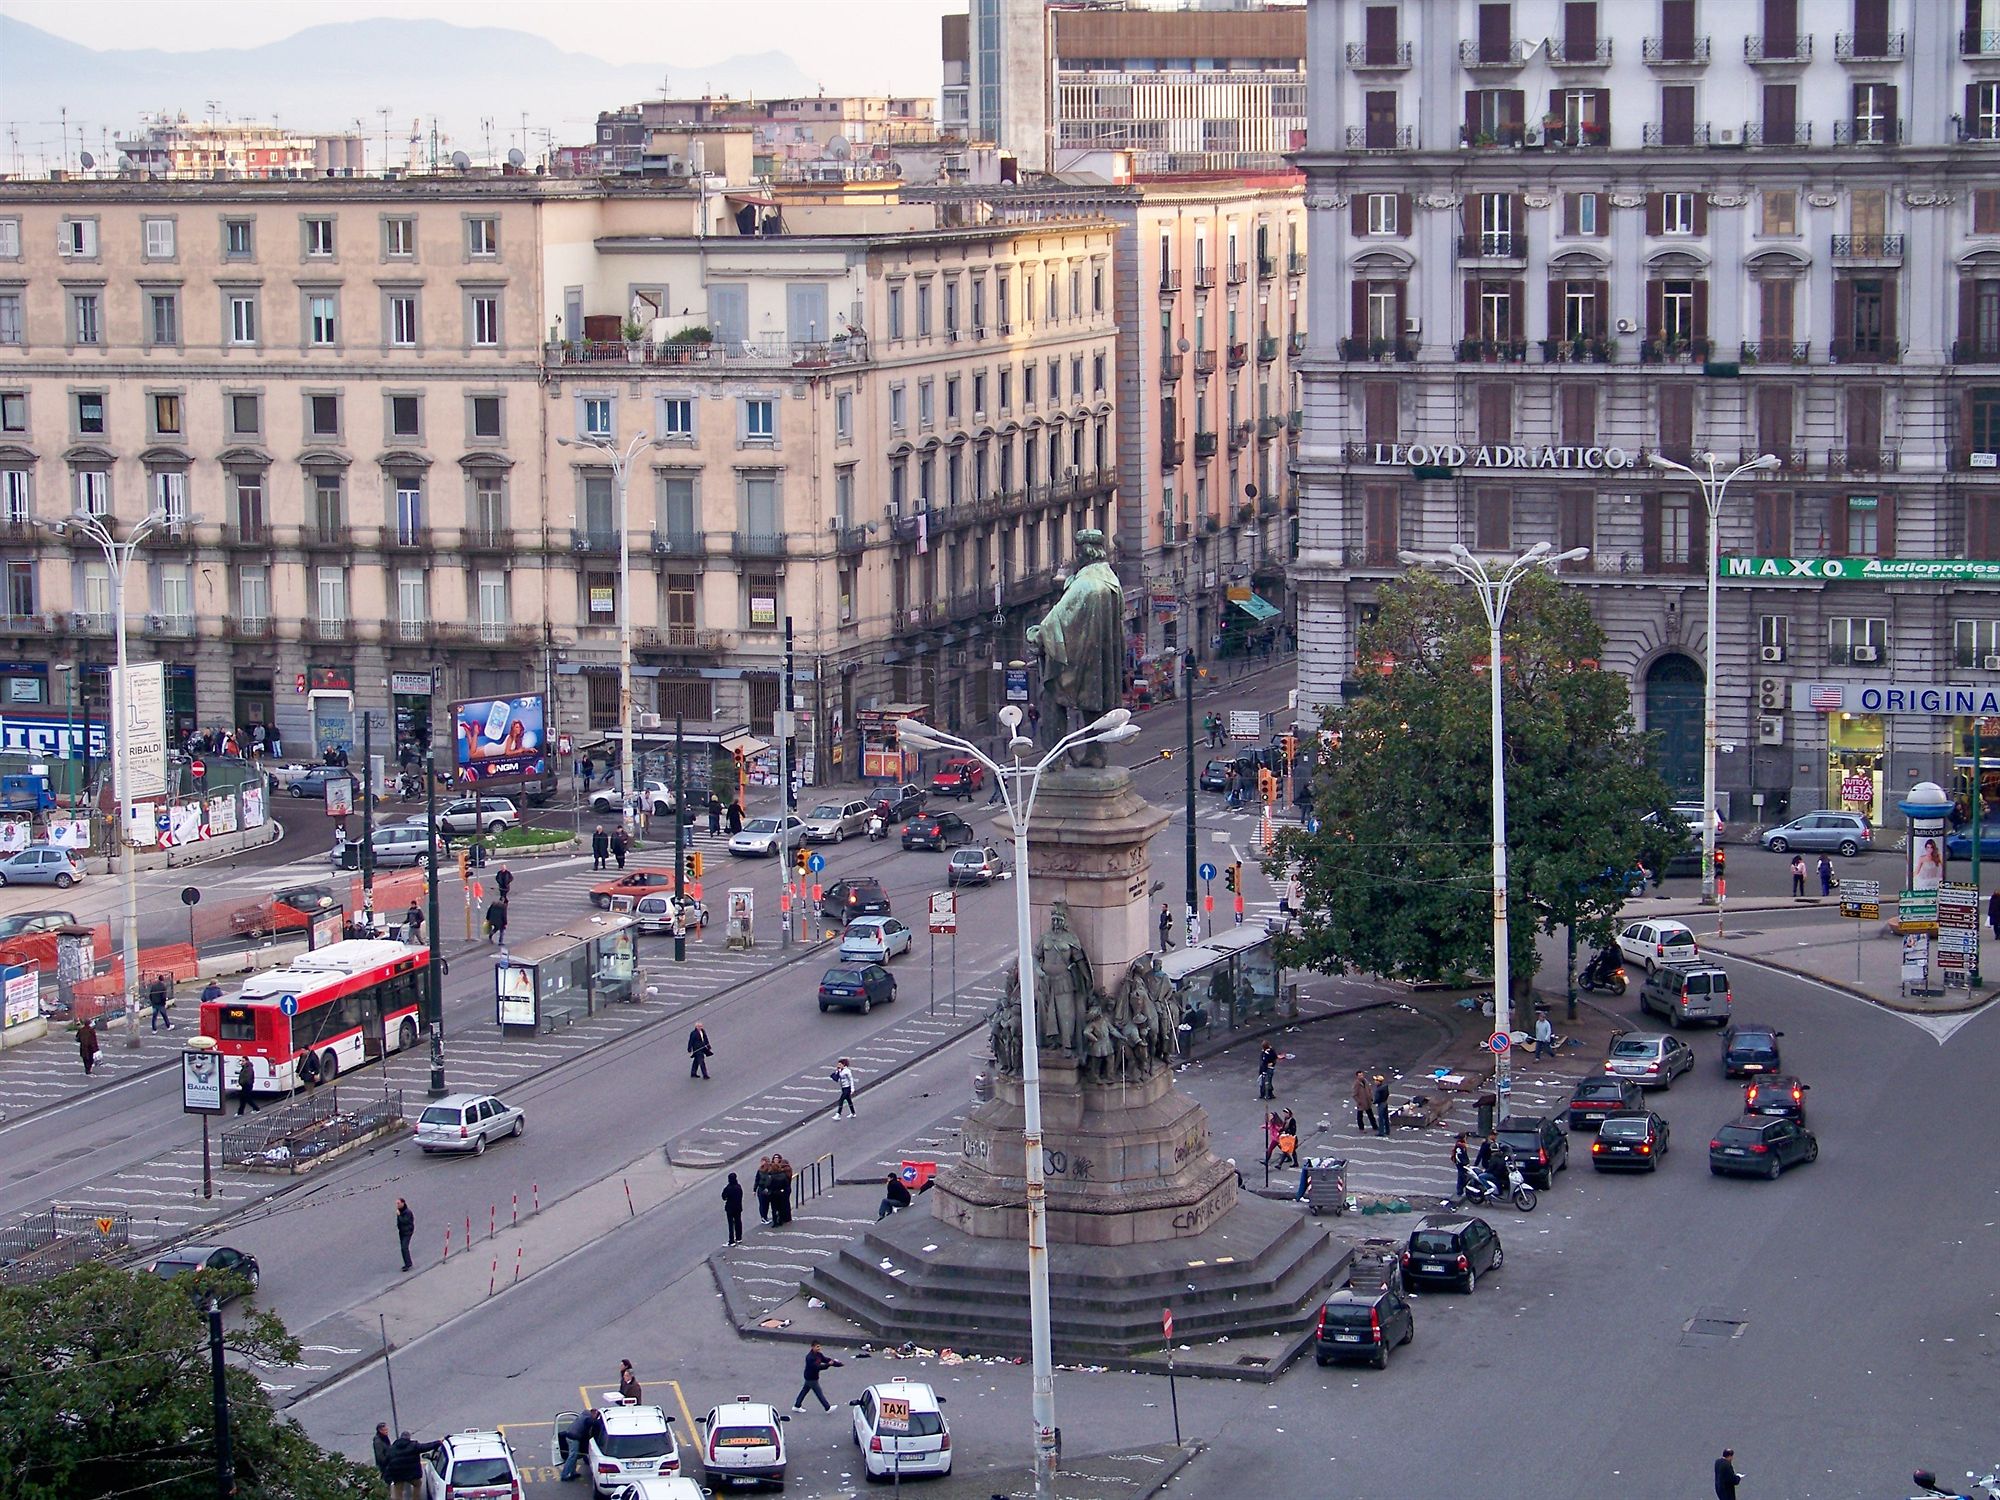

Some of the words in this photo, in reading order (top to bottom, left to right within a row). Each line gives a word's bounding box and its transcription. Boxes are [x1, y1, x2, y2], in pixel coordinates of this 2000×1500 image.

[1375, 443, 1466, 467] LLOYD
[1474, 445, 1626, 469] ADRIATICO
[1861, 688, 2000, 713] ORIGINA
[496, 762, 519, 772] NGM
[1844, 778, 1863, 786] TUTTO
[1844, 793, 1870, 801] PREZZO
[187, 1083, 218, 1091] BAIANO
[883, 1402, 907, 1415] TAXI
